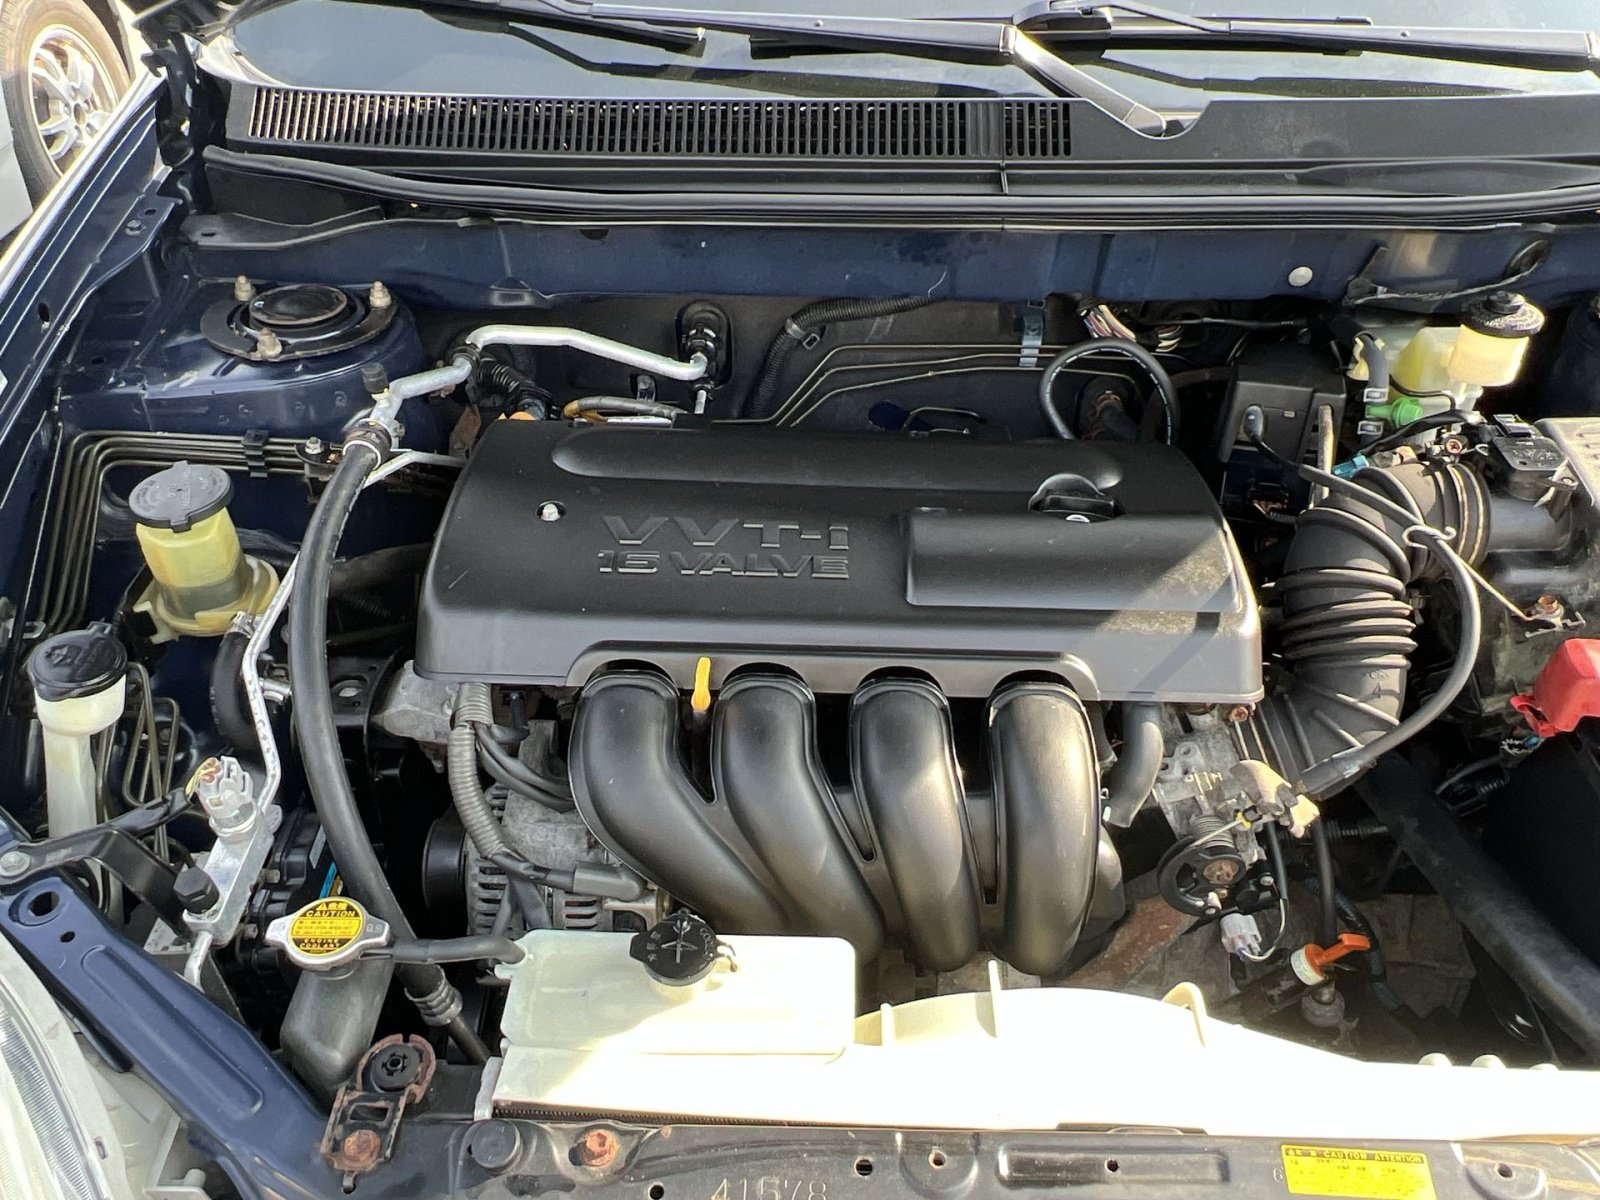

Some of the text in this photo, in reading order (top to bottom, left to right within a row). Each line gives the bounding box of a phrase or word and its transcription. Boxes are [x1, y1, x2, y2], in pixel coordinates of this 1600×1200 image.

[598, 549, 849, 579] 16 VALVE
[1323, 1150, 1367, 1160] CAUTION
[1374, 1153, 1424, 1163] ATTENTION
